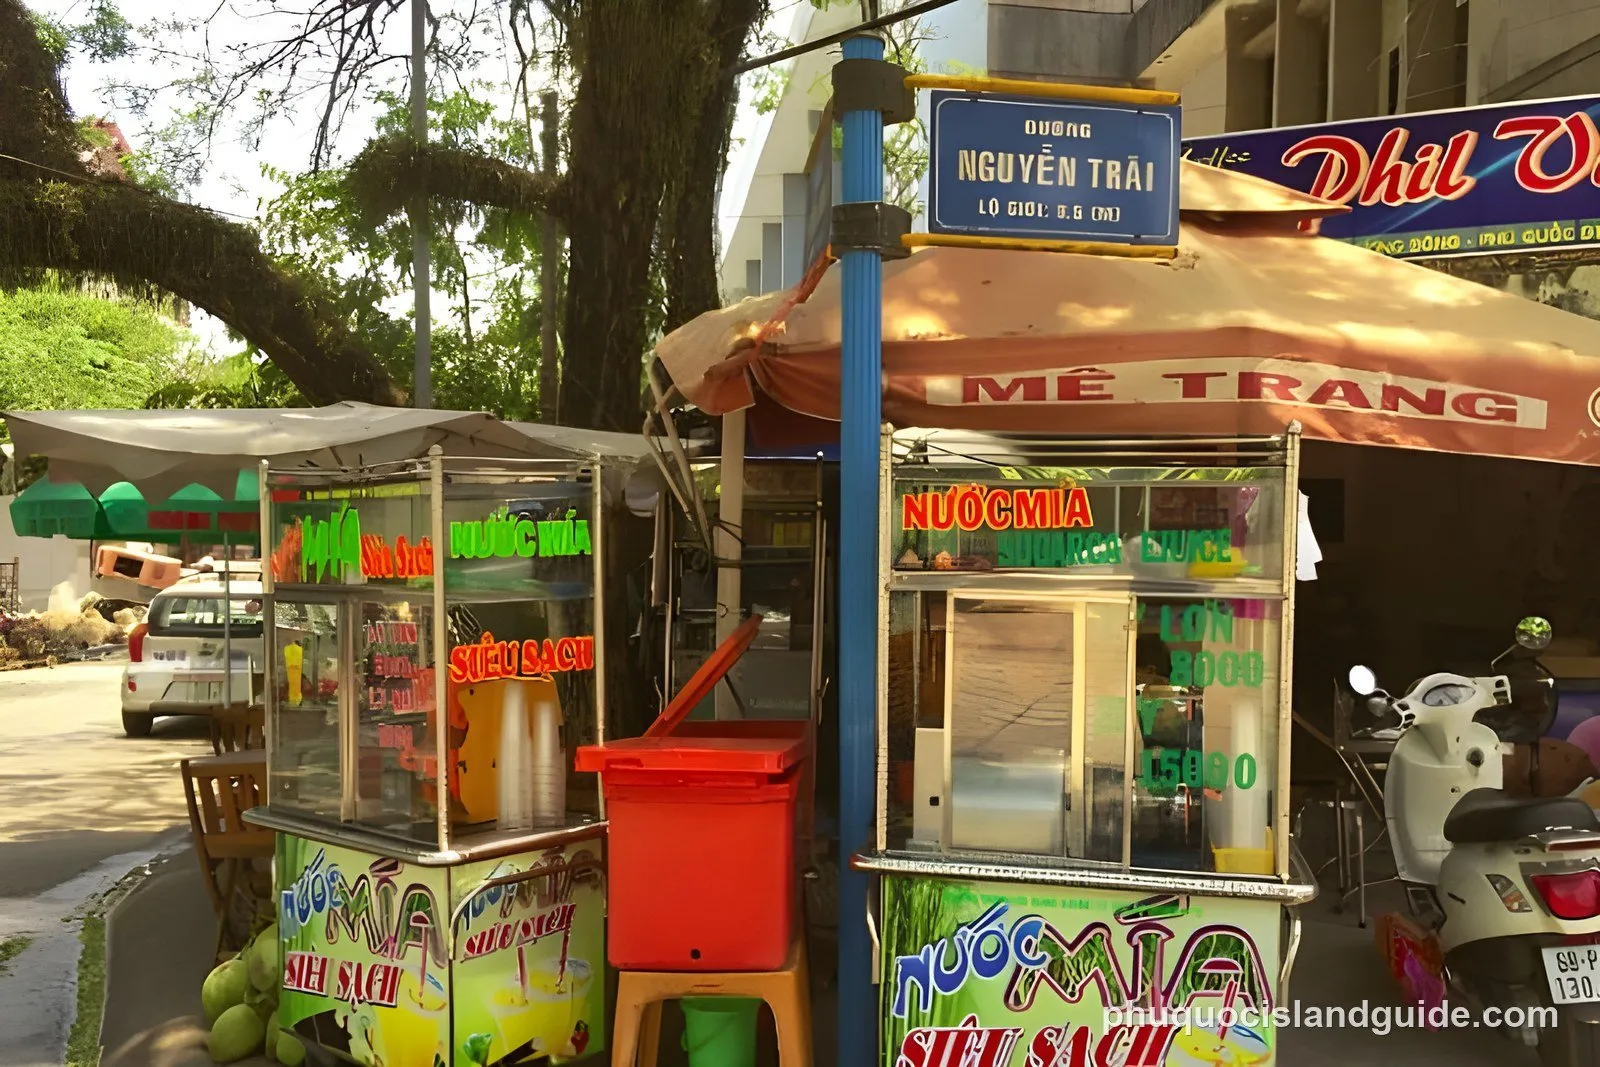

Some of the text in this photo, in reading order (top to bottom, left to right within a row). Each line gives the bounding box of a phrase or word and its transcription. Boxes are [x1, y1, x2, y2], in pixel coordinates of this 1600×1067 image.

[1493, 111, 1600, 194] V
[962, 367, 1517, 422] MÊ TRANG
[1004, 894, 1275, 1015] MÍA
